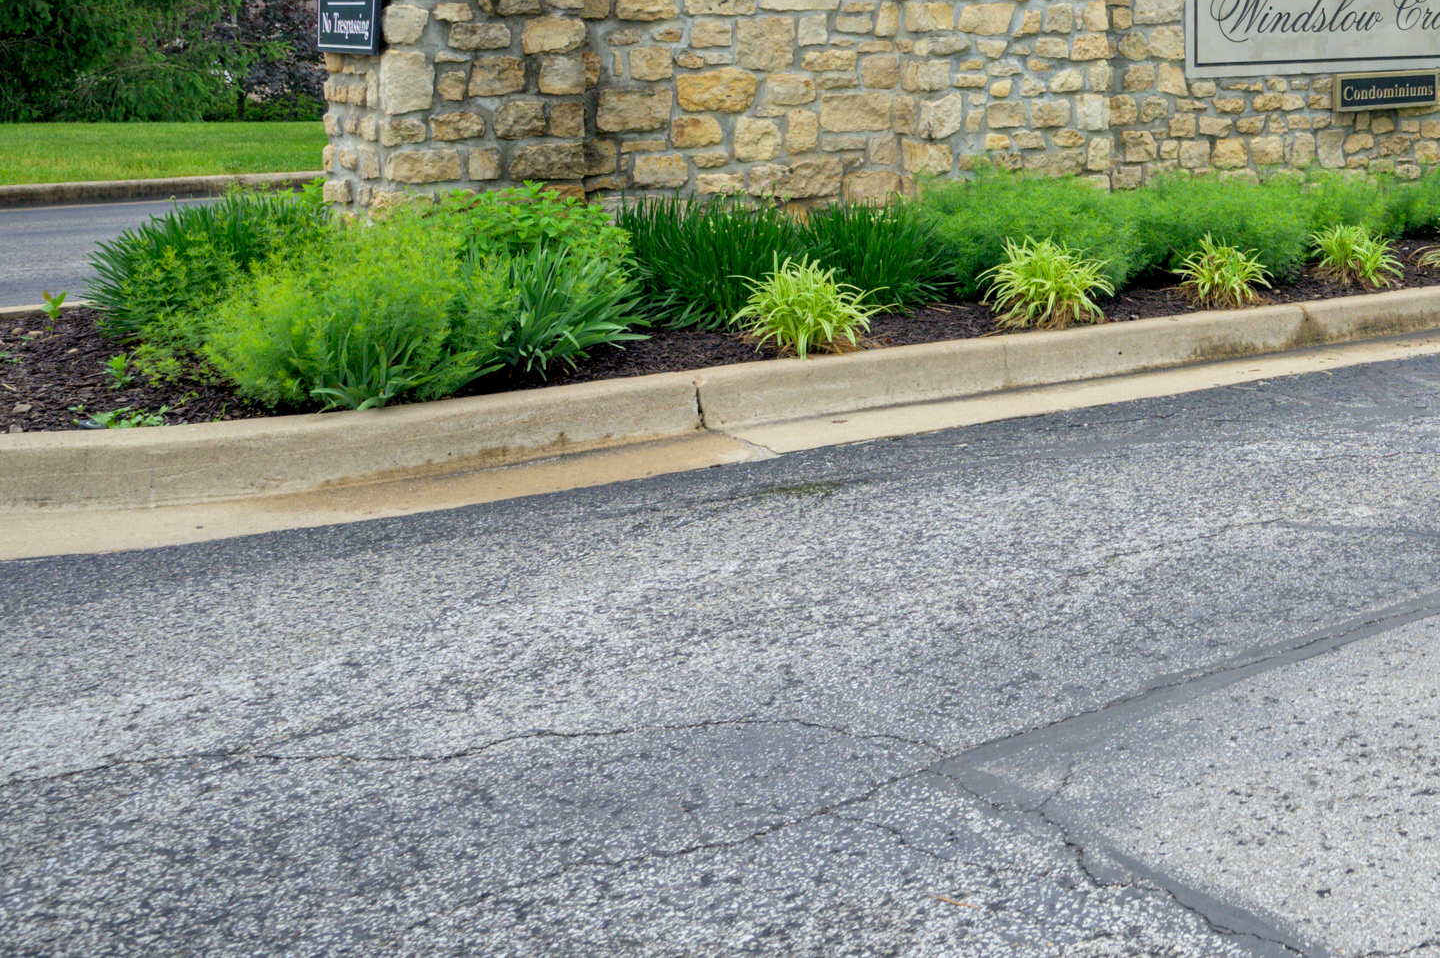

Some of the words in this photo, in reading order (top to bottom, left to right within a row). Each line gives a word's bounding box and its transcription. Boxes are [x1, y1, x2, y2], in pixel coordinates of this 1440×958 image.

[322, 12, 331, 33] No
[333, 12, 370, 40] Trespassing
[1343, 83, 1433, 101] Condominiums
